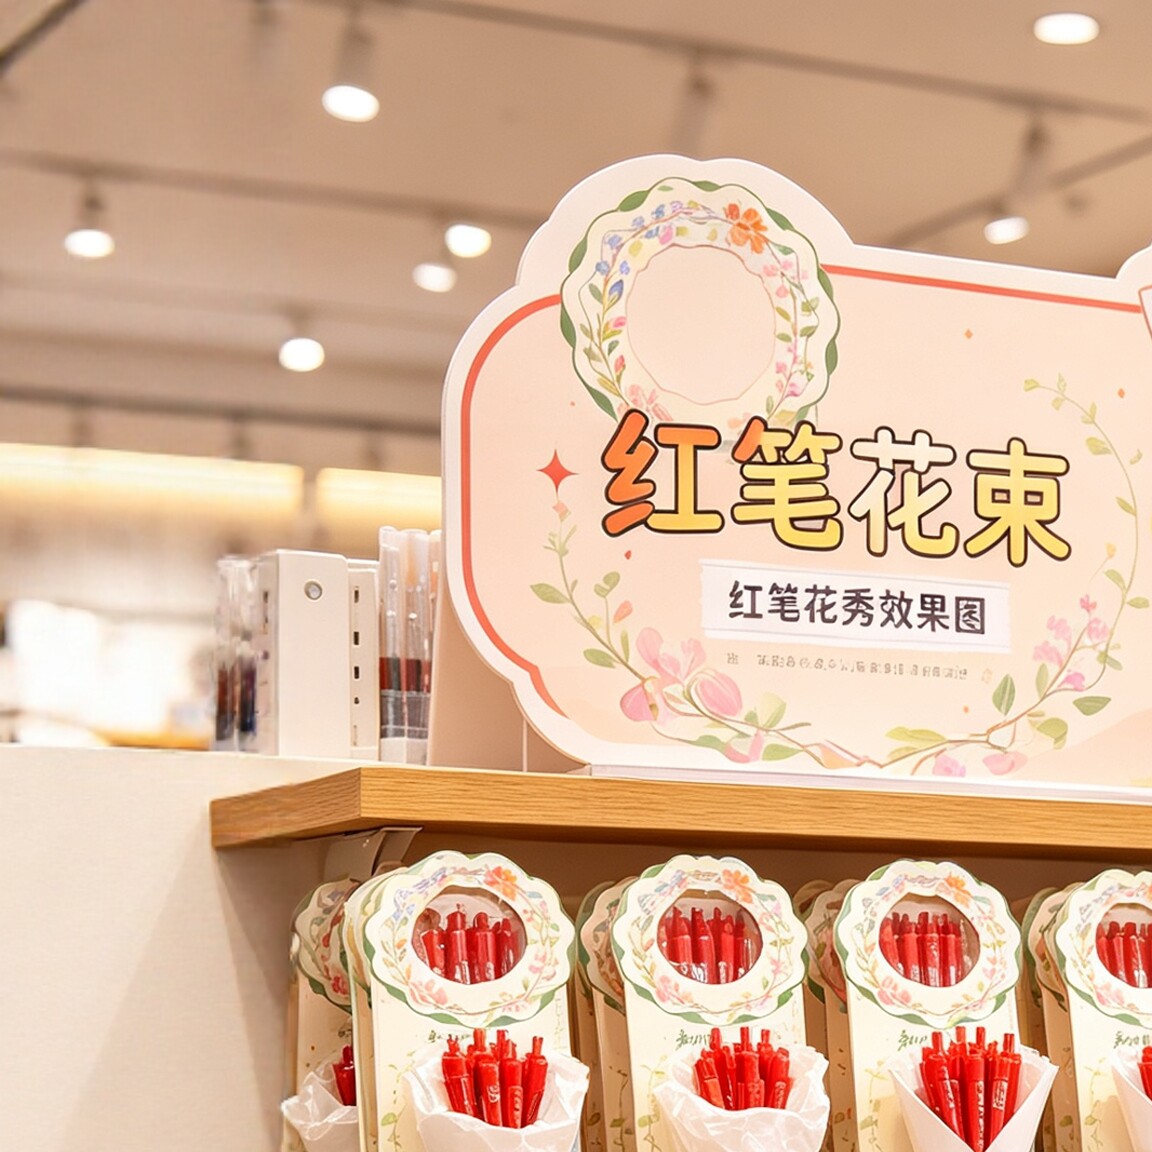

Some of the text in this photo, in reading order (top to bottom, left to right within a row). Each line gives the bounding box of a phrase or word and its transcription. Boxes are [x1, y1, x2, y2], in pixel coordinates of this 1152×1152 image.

[601, 408, 1072, 568] 红笔花束
[728, 580, 986, 635] 红笔花秀效果图
